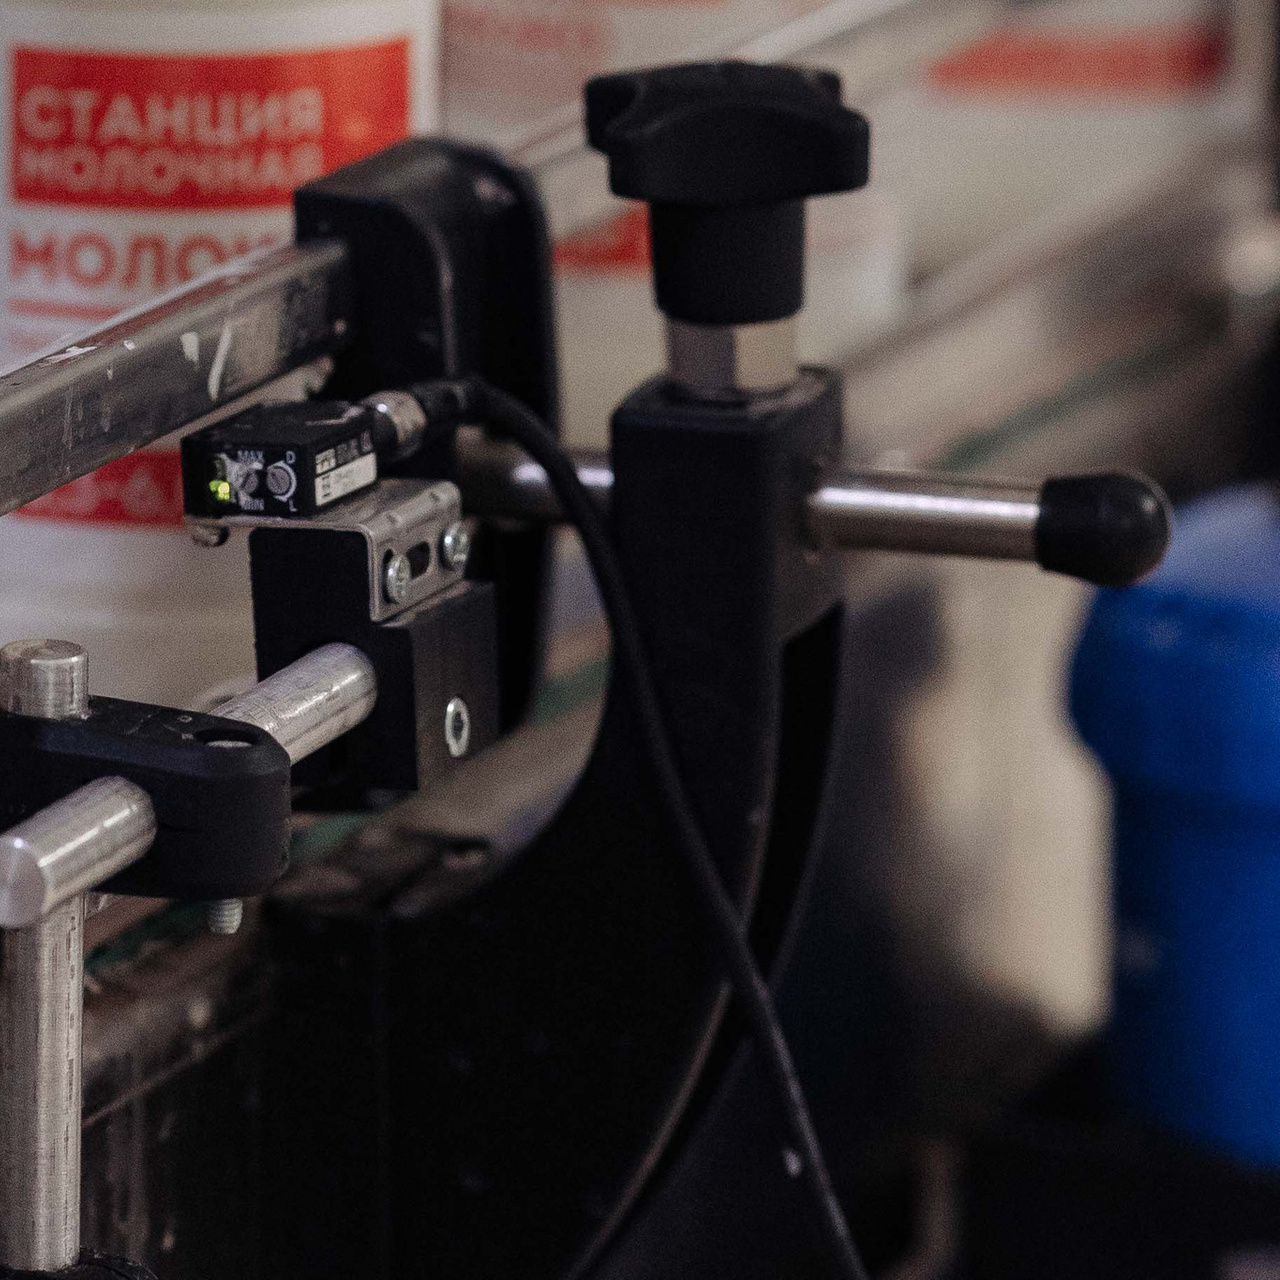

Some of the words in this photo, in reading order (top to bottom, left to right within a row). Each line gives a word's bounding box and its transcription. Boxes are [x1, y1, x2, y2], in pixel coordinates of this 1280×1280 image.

[22, 86, 321, 144] СТАНЦИЯ
[237, 450, 265, 463] MAX
[286, 450, 297, 464] D
[289, 500, 298, 512] L
